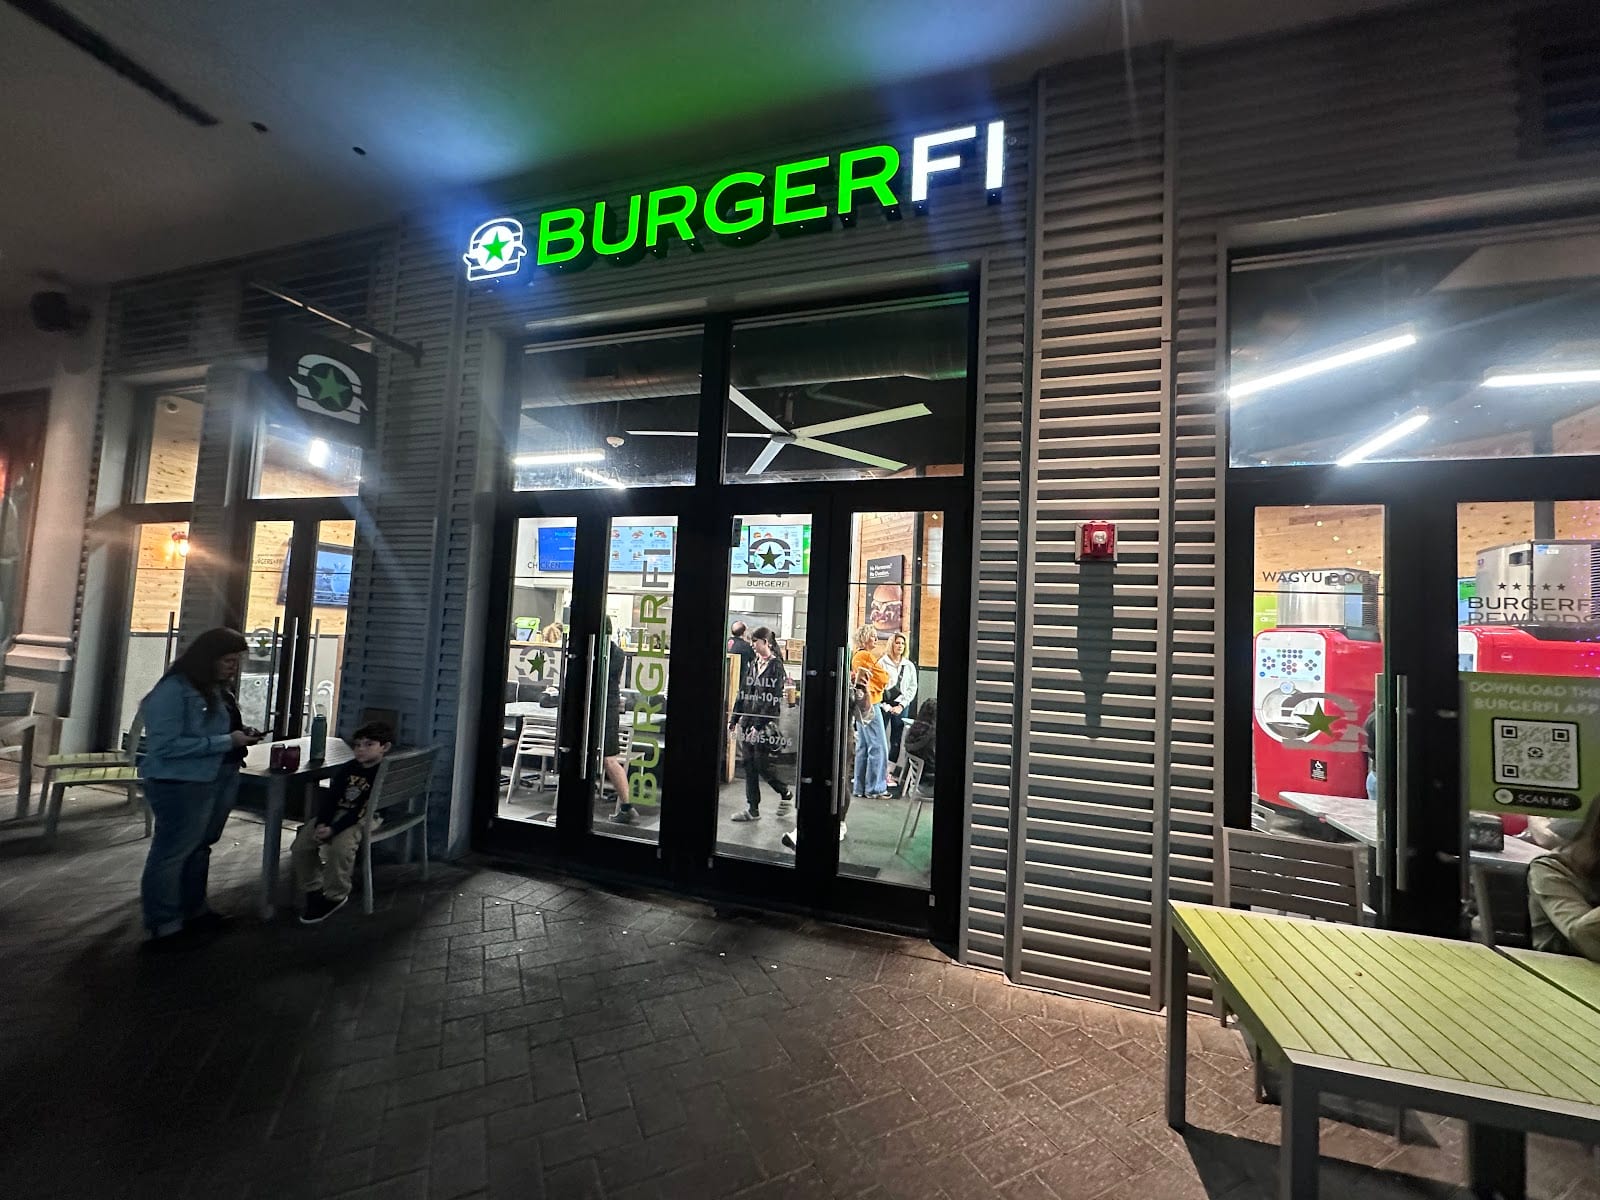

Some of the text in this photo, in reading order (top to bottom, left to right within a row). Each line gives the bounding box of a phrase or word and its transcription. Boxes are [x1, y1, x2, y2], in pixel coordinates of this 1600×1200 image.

[537, 120, 1004, 266] BURGERFI
[746, 580, 790, 588] BURGERFI
[1262, 571, 1322, 583] WAGYU
[1468, 597, 1592, 612] BURGERF
[628, 548, 671, 806] BURGERFI
[746, 676, 778, 688] DAILY
[1470, 681, 1567, 696] DOWNLOAD
[1474, 697, 1600, 714] BURGERFI APP
[1518, 793, 1569, 807] SCAN ME
